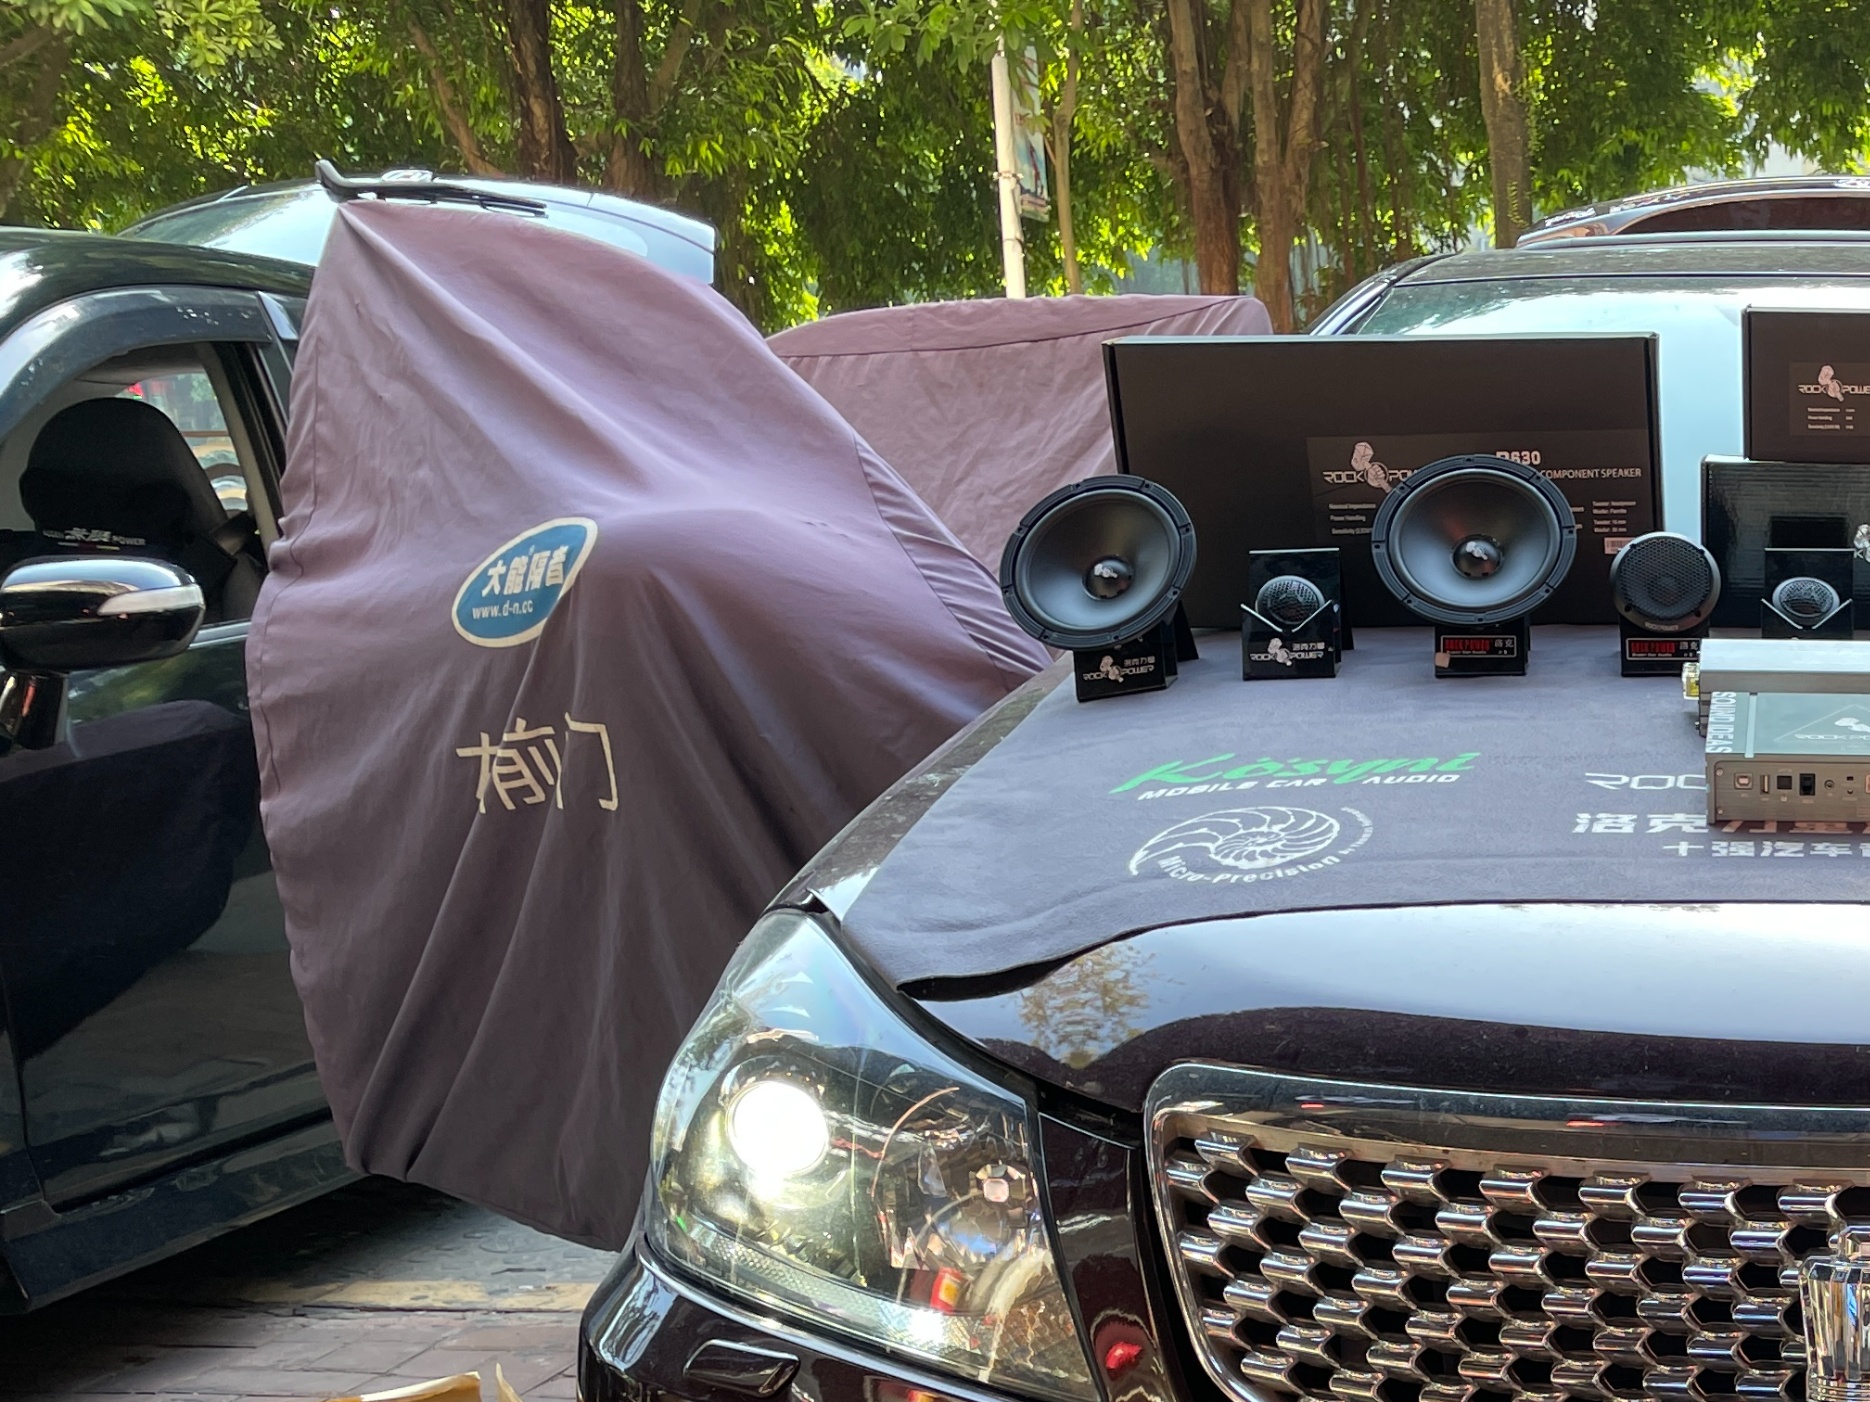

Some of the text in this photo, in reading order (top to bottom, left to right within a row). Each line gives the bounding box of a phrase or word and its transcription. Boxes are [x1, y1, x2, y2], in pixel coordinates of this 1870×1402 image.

[1323, 470, 1365, 484] ROCK
[1601, 467, 1642, 479] SPEAKER
[472, 598, 534, 620] www.d-n.cc
[1289, 651, 1324, 660] POWER
[1121, 665, 1155, 676] POWER
[1705, 691, 1737, 753] SOUND IDEAS
[1137, 774, 1461, 800] MOBILE CAR AUDIO
[1158, 854, 1341, 885] Micro-Precision
